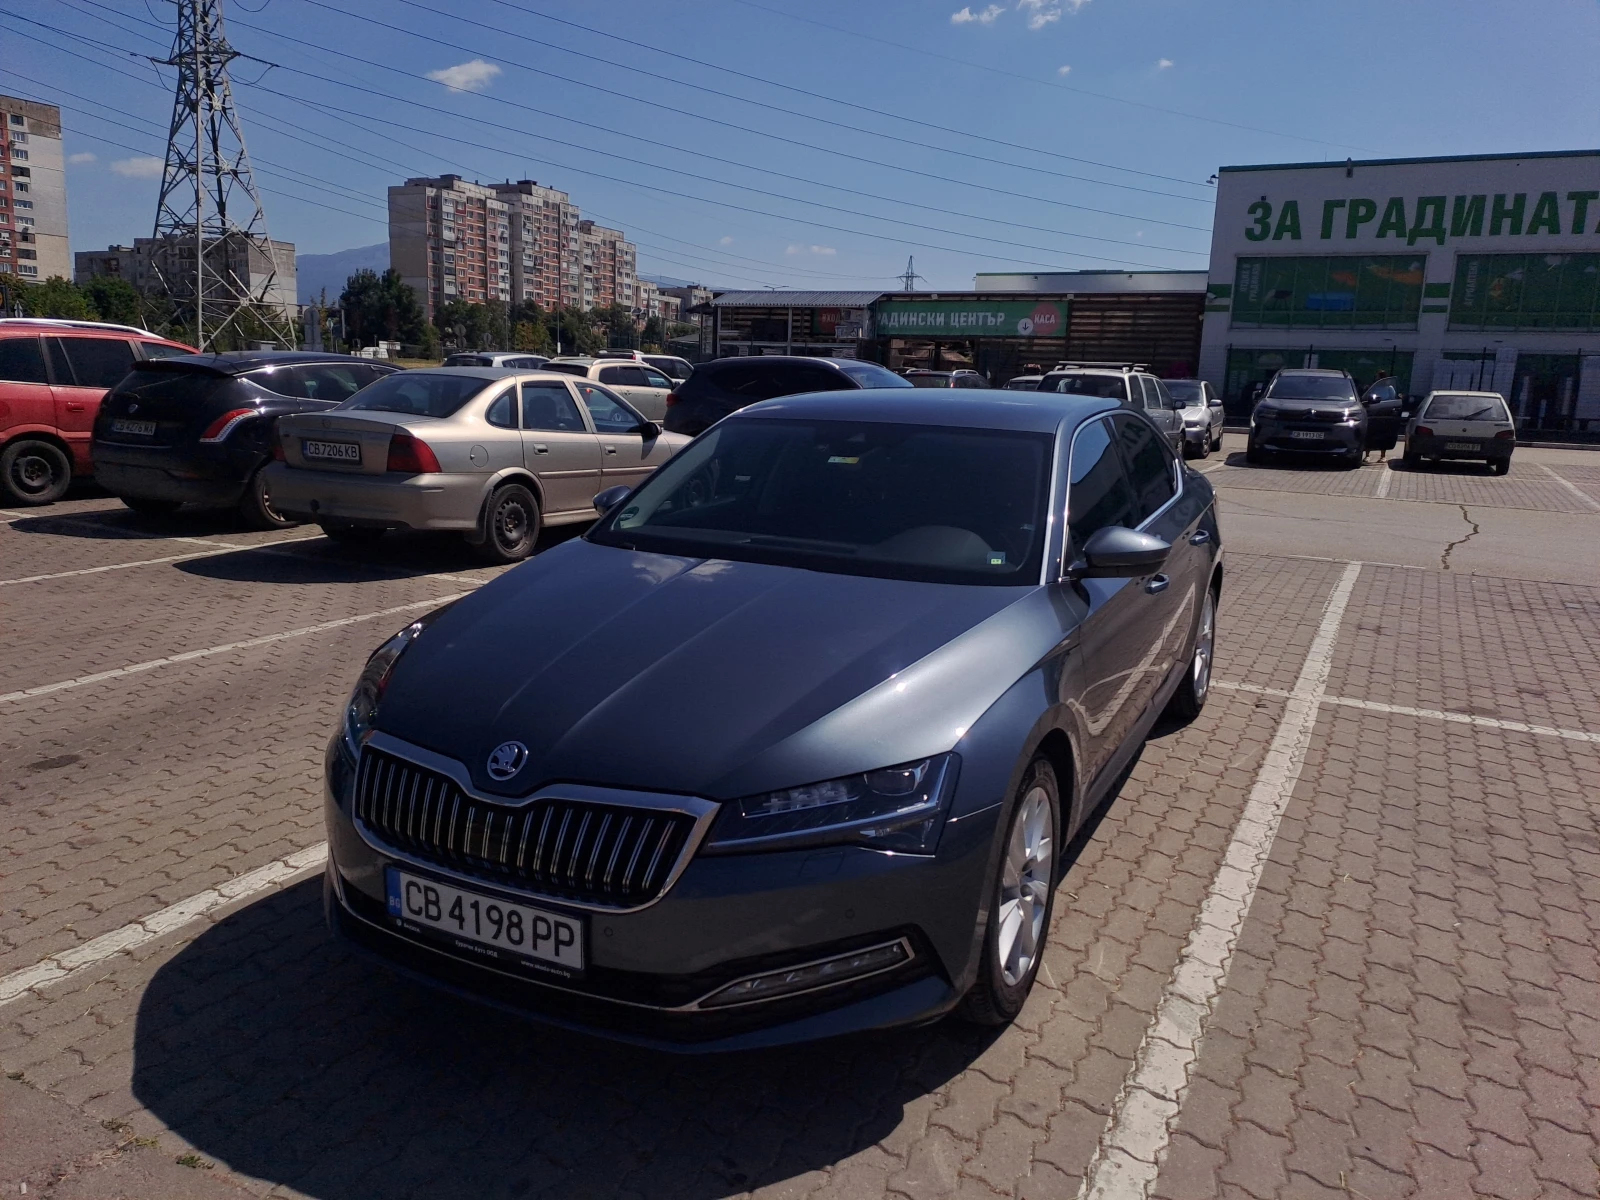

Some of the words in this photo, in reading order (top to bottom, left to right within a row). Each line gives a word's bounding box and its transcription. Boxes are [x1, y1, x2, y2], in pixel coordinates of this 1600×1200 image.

[1244, 200, 1302, 242] ЗА
[1319, 190, 1600, 246] ГРАДИНАТ
[950, 311, 1006, 328] ЦЕНТЪР
[1034, 314, 1056, 324] КАСА
[389, 895, 401, 909] BG
